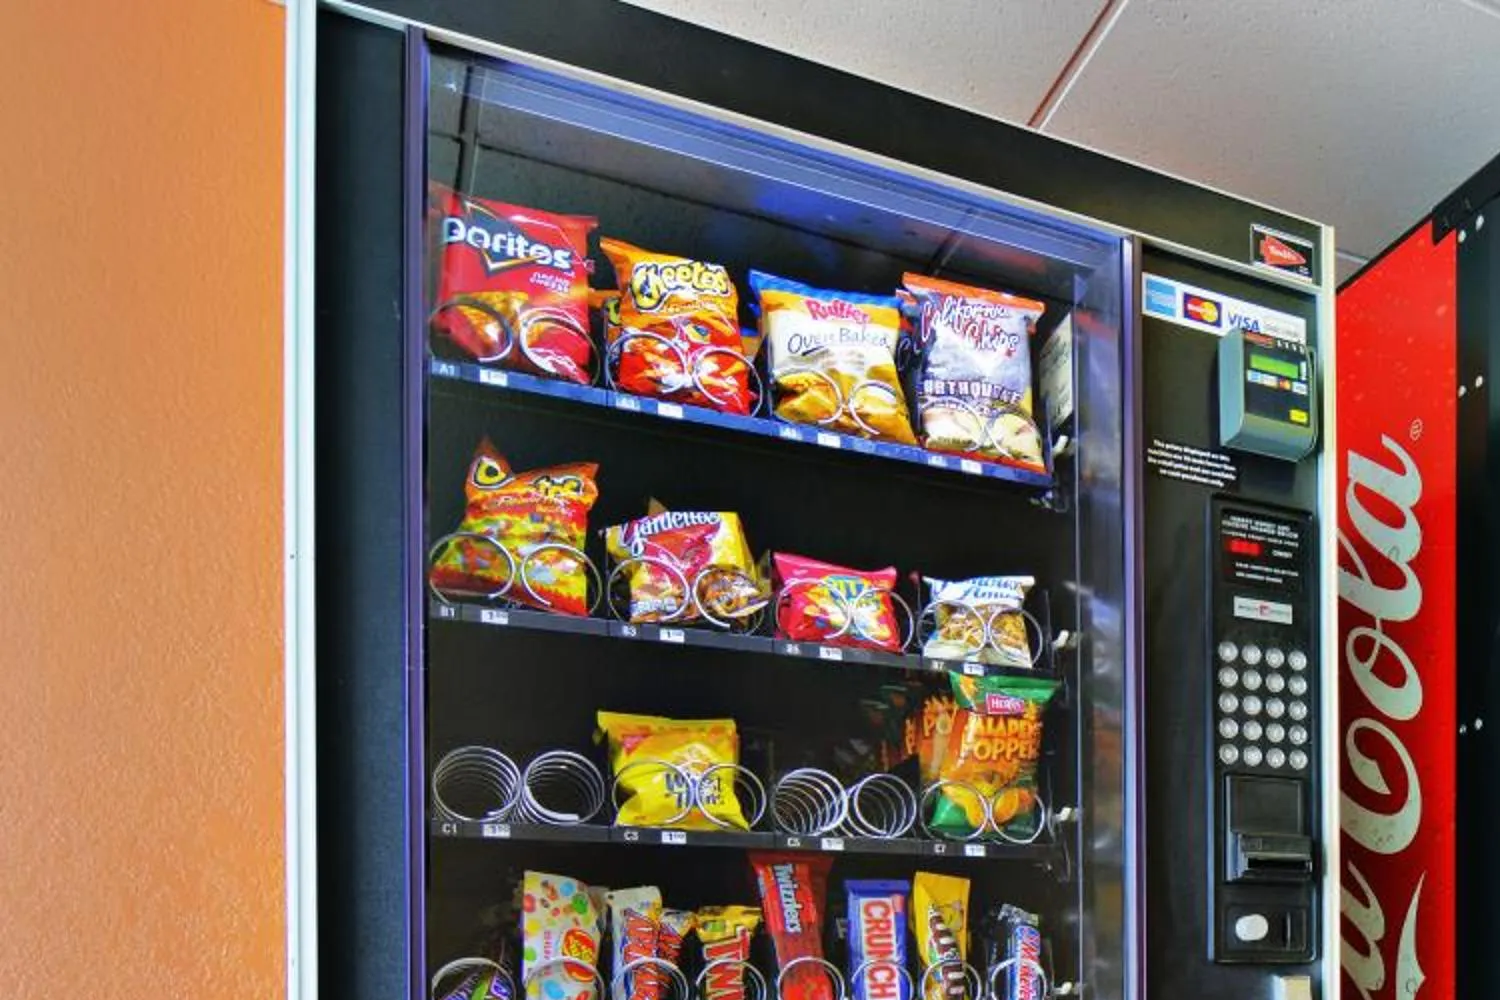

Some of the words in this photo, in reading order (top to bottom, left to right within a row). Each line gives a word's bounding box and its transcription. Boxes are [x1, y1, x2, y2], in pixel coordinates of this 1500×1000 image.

[443, 217, 572, 269] Doritos
[631, 262, 730, 311] Cheetos
[839, 327, 889, 348] Baked
[1228, 312, 1261, 331] VISA
[863, 900, 898, 999] CRUNCH
